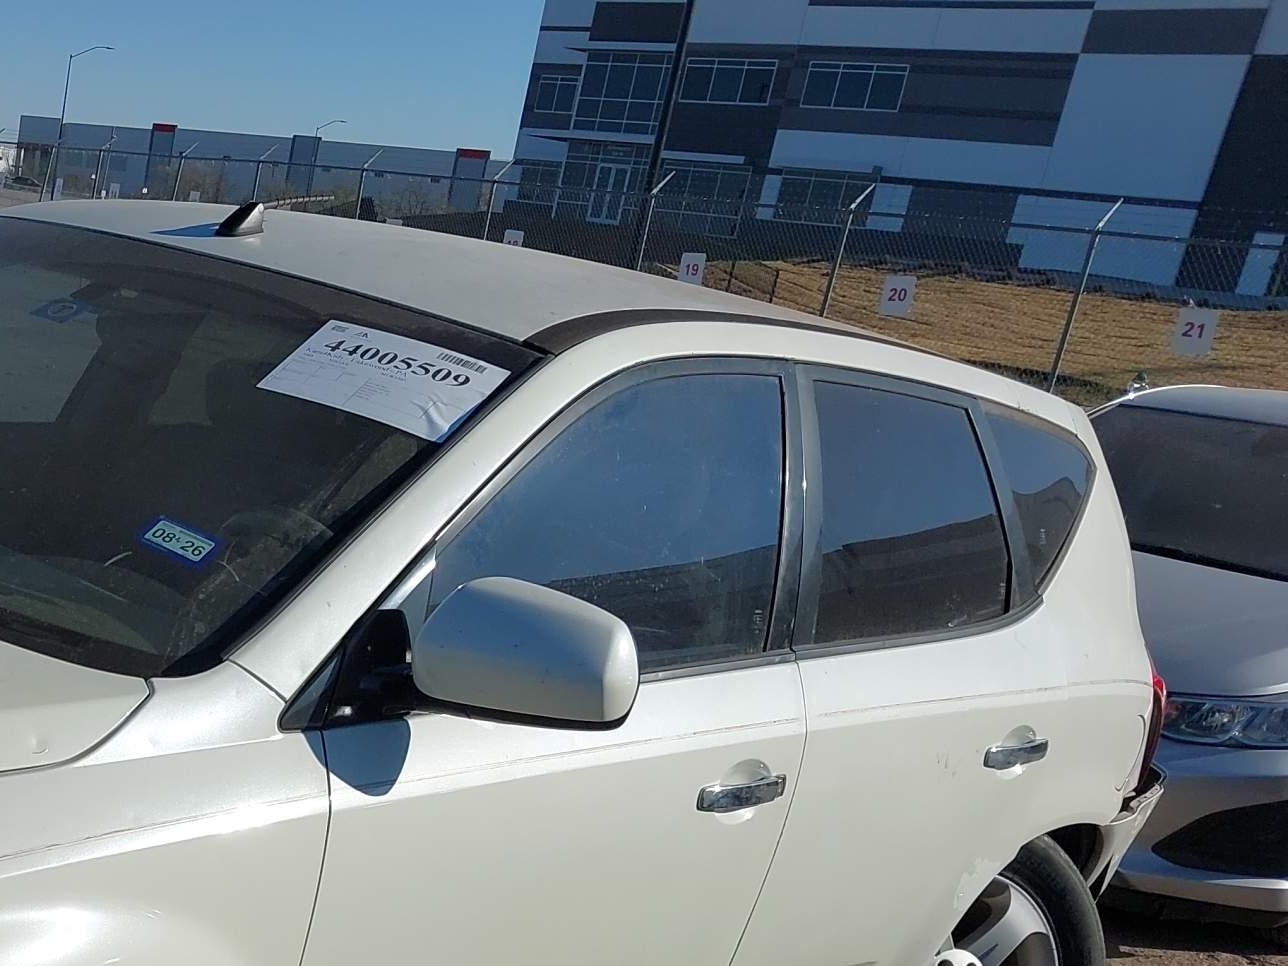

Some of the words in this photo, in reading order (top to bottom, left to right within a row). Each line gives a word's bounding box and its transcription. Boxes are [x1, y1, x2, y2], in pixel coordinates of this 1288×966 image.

[685, 263, 699, 276] 19
[888, 287, 907, 302] 20
[1182, 321, 1206, 339] 21
[323, 339, 471, 387] 44005509
